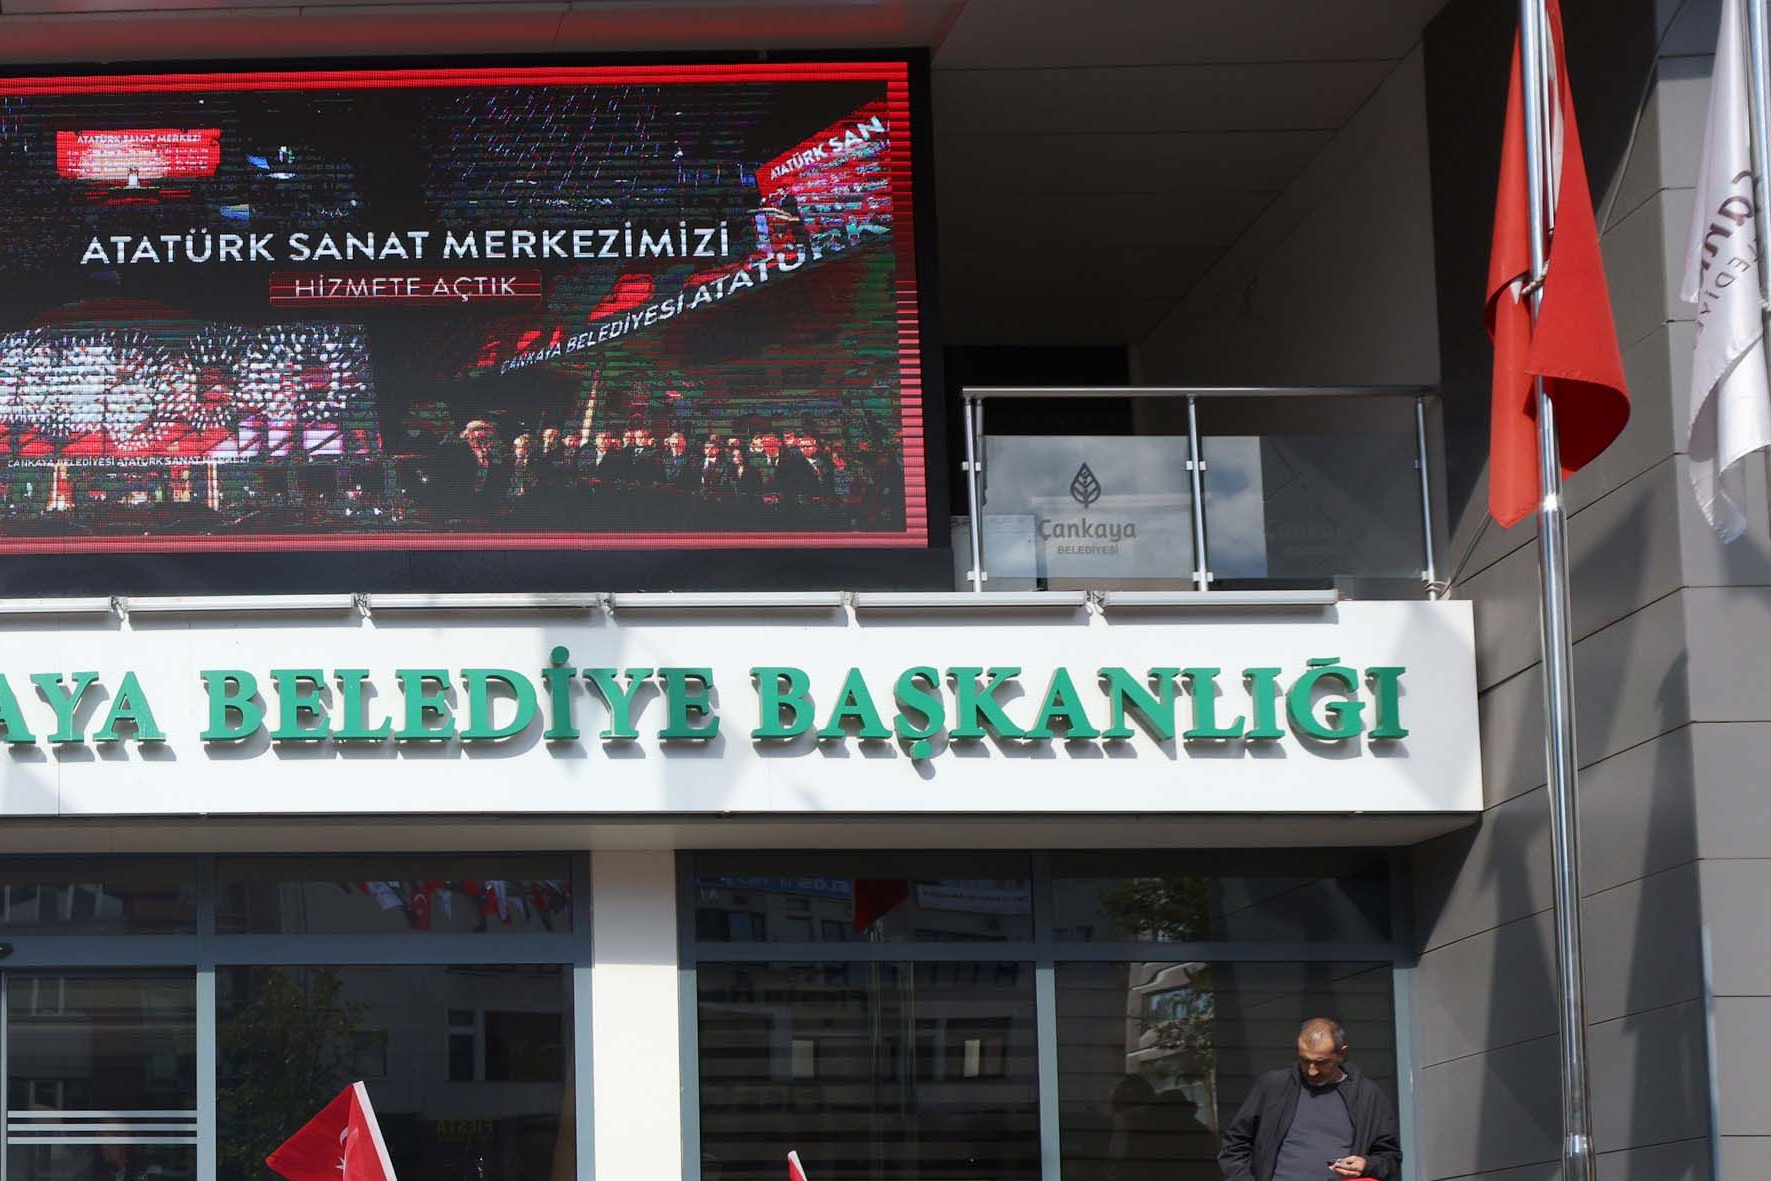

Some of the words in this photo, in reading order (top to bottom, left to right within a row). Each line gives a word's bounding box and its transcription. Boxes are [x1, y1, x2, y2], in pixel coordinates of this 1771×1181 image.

[770, 142, 828, 180] ATATÜRK
[80, 228, 275, 264] ATATÜRK
[289, 231, 429, 262] SANAT
[442, 221, 730, 260] MERKEZİMİZİ
[294, 273, 420, 298] HİZMETE
[432, 276, 517, 302] AÇTIK
[566, 289, 685, 354] BELEDİYESİ
[1037, 517, 1137, 542] Çankaya
[1057, 543, 1119, 555] BELEDİYESİ
[200, 645, 720, 743] BELEDİYE
[749, 656, 1410, 760] BAŞKANLIĞI
